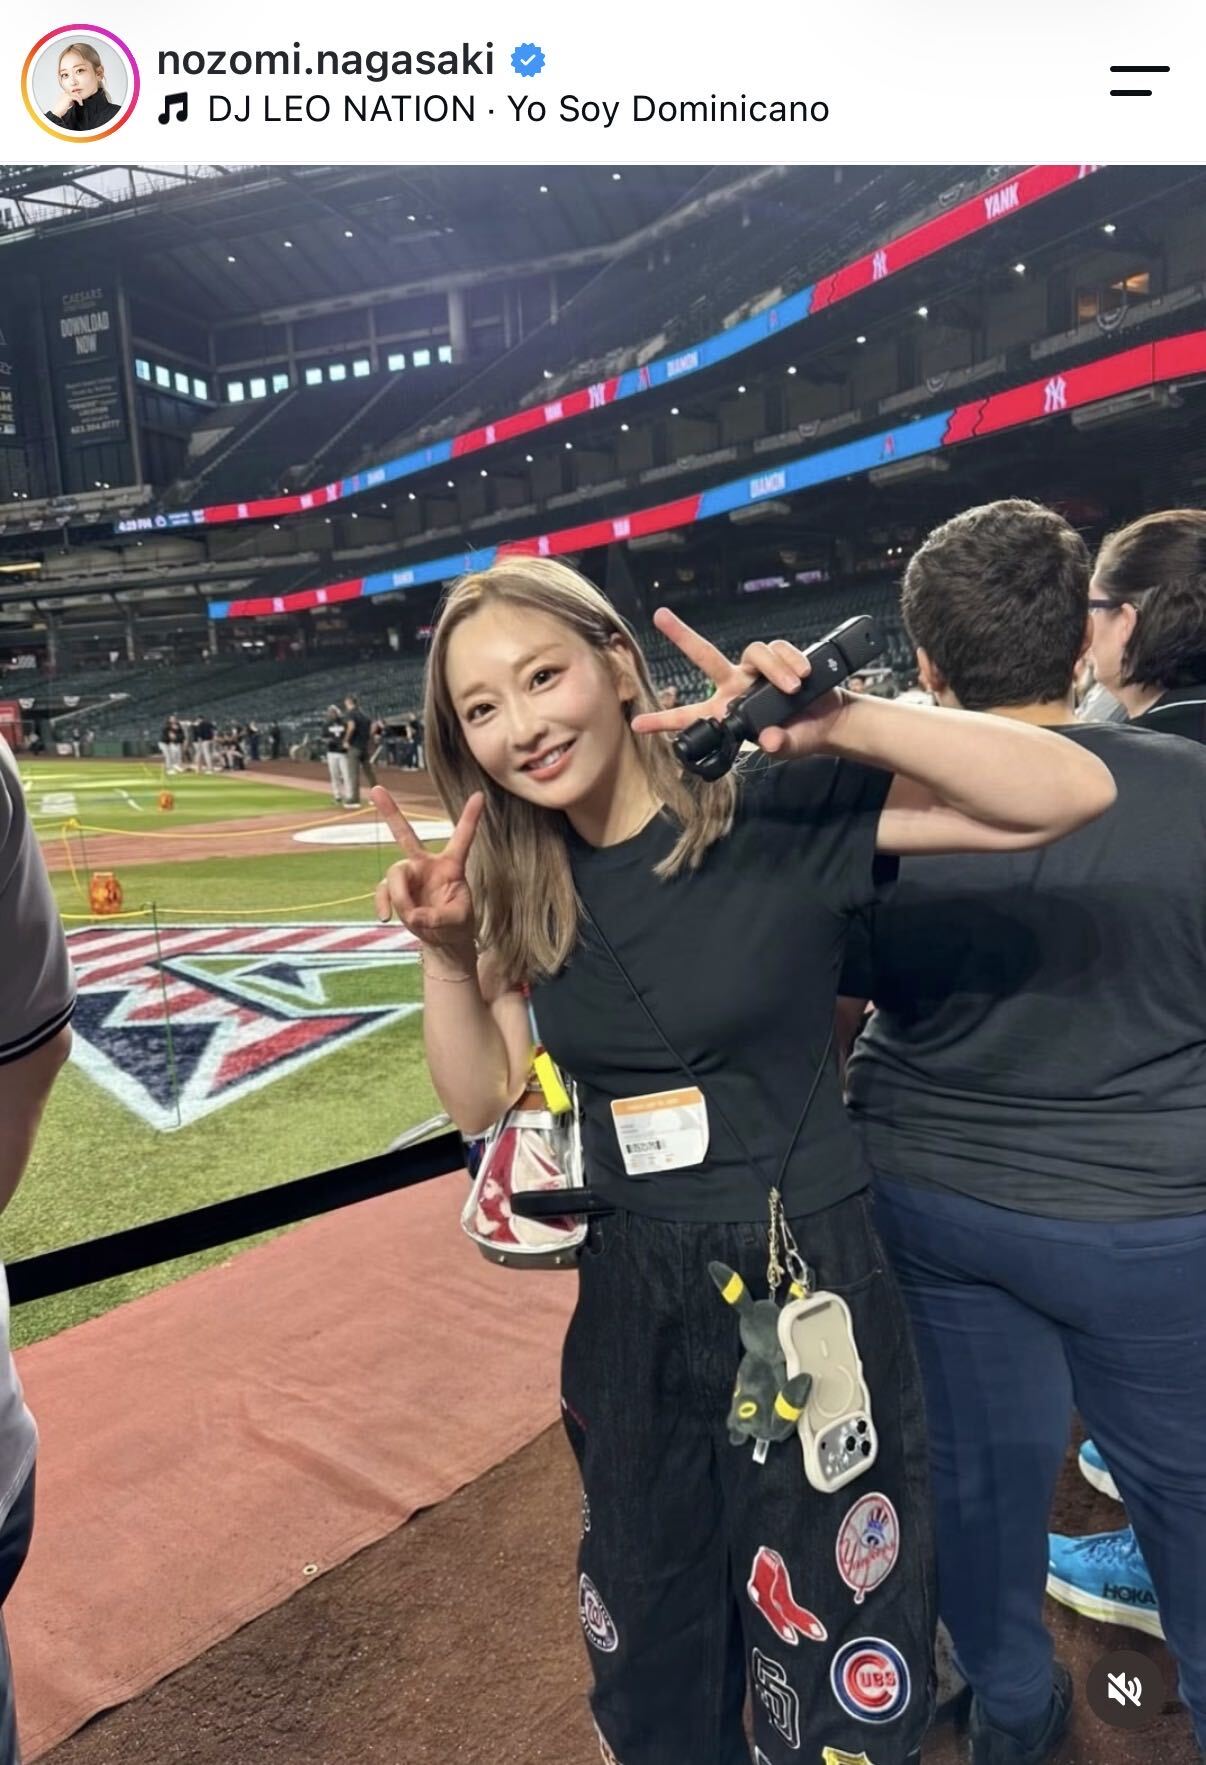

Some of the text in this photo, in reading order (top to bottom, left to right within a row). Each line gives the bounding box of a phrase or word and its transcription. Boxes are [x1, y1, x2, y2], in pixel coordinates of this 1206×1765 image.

[984, 182, 1019, 220] YANK
[60, 311, 109, 338] DOWNLOAD
[75, 333, 98, 355] NOW
[1103, 1582, 1157, 1605] HOKA
